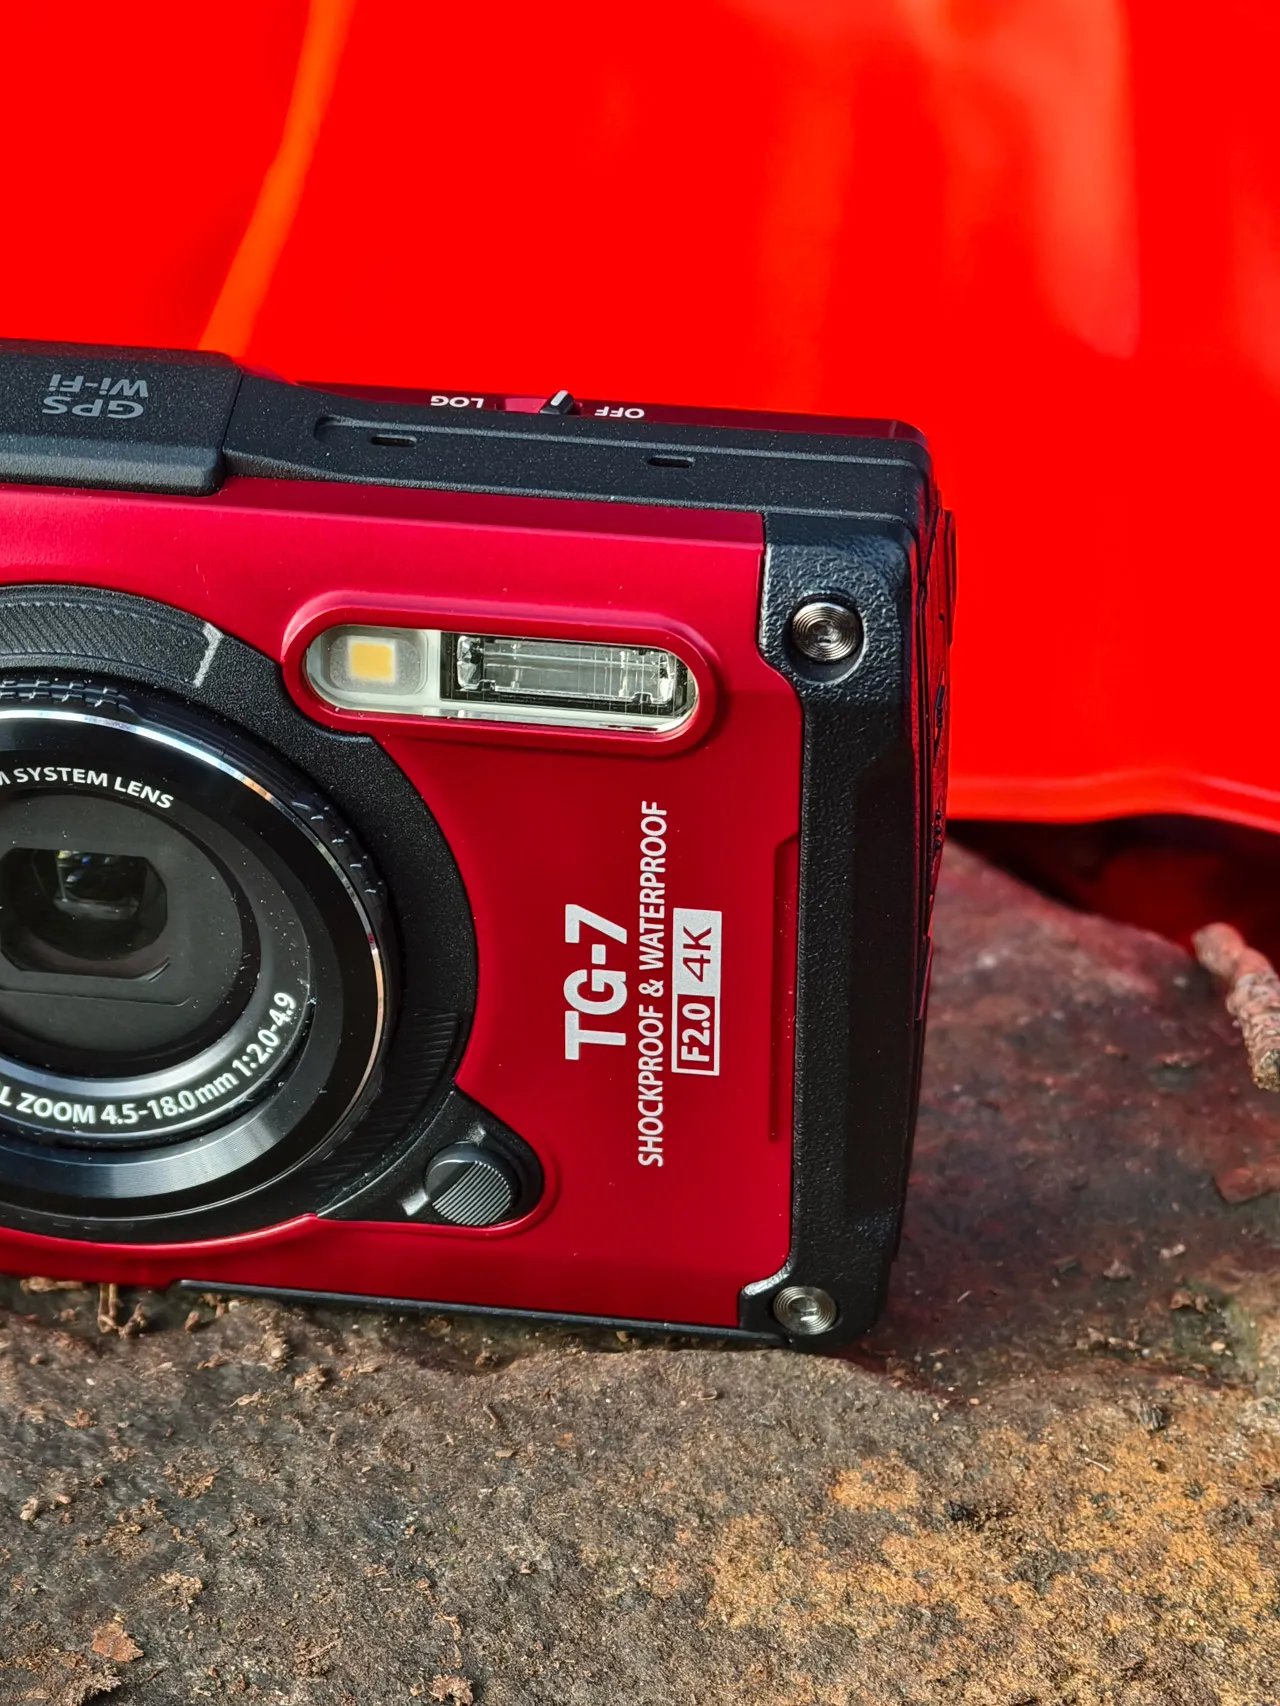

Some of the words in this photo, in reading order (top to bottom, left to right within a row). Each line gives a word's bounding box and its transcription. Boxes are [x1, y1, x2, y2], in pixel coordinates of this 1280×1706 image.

[42, 396, 145, 420] GPS
[48, 374, 149, 398] Wi-Fi
[430, 395, 484, 409] LOG
[594, 406, 645, 419] OFF
[13, 766, 108, 787] SYSTEM
[113, 776, 174, 809] LENS
[638, 800, 667, 971] WATERPROOF
[682, 926, 712, 983] 4K
[563, 903, 628, 1061] TG-7
[638, 979, 664, 998] &
[681, 1002, 711, 1063] F2.0
[16, 1092, 97, 1124] ZOOM
[100, 1072, 239, 1125] 4.5-18.0mm
[232, 991, 297, 1077] 1:2.0-4.9
[638, 1004, 664, 1168] SHOCKPROOF
